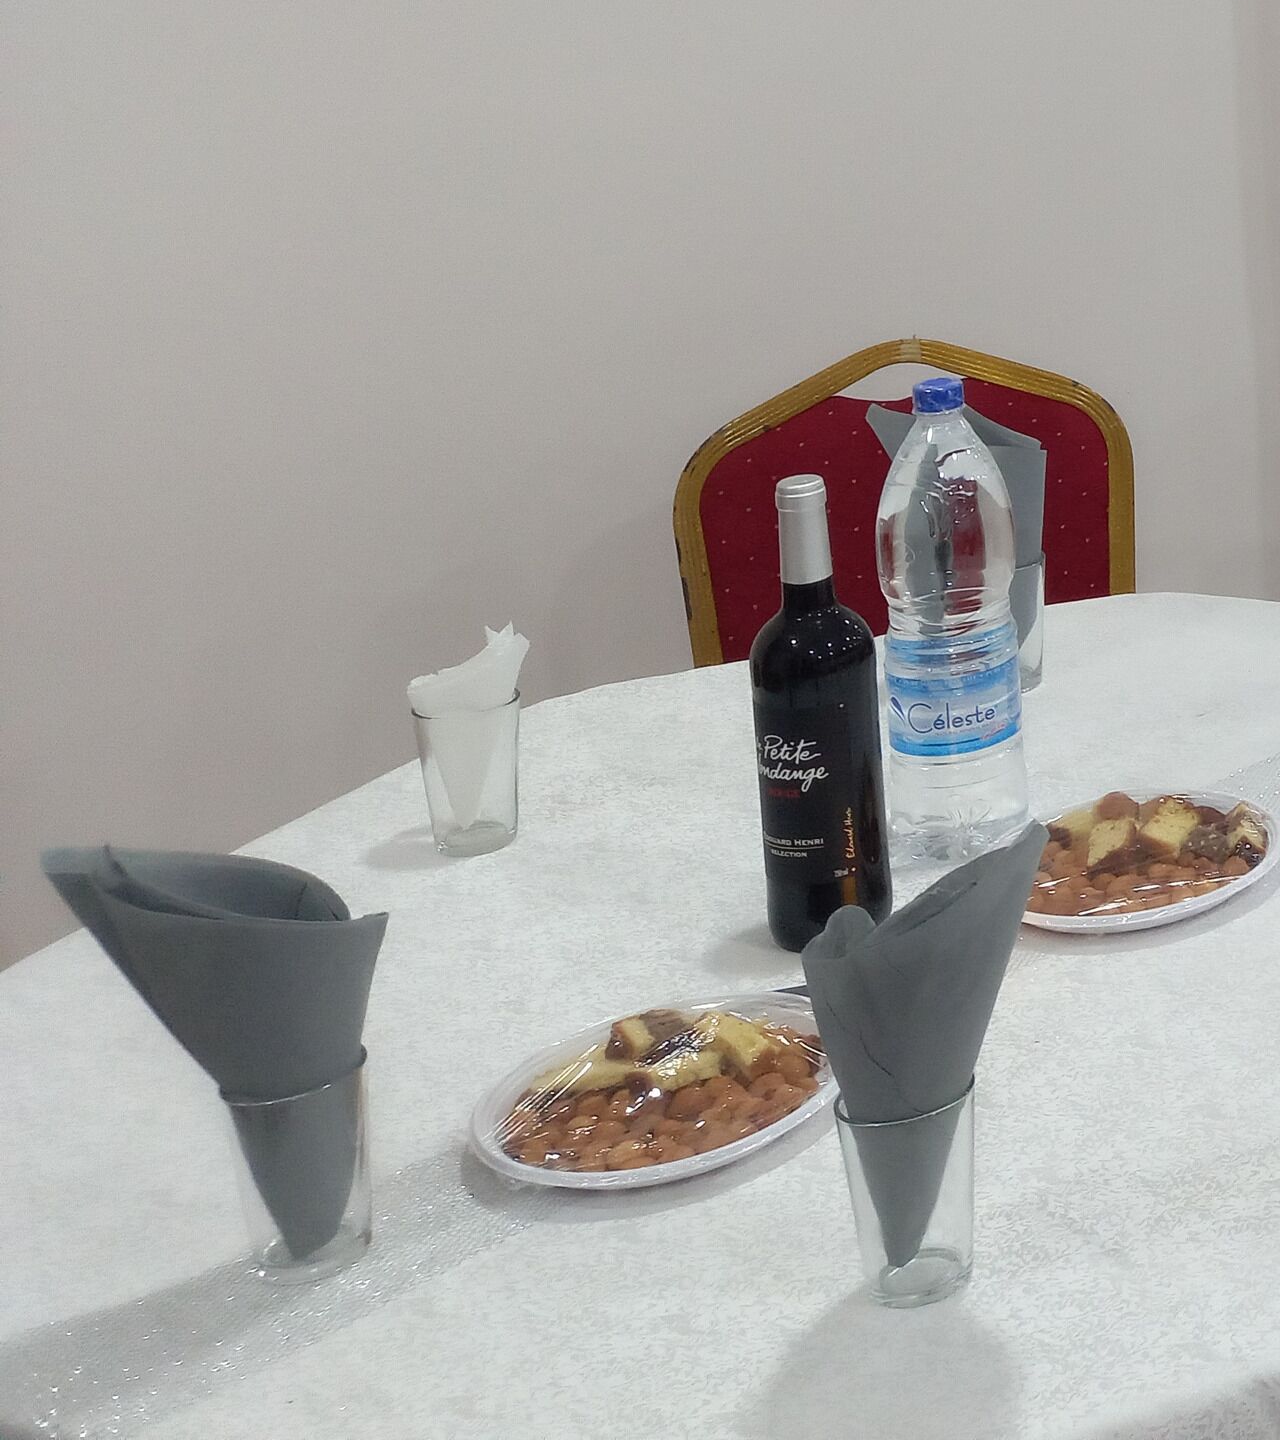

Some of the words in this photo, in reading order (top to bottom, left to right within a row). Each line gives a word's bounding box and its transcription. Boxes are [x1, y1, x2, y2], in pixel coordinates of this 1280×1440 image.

[908, 702, 996, 735] Céleste
[763, 733, 822, 765] Petite
[794, 837, 825, 846] HENRI
